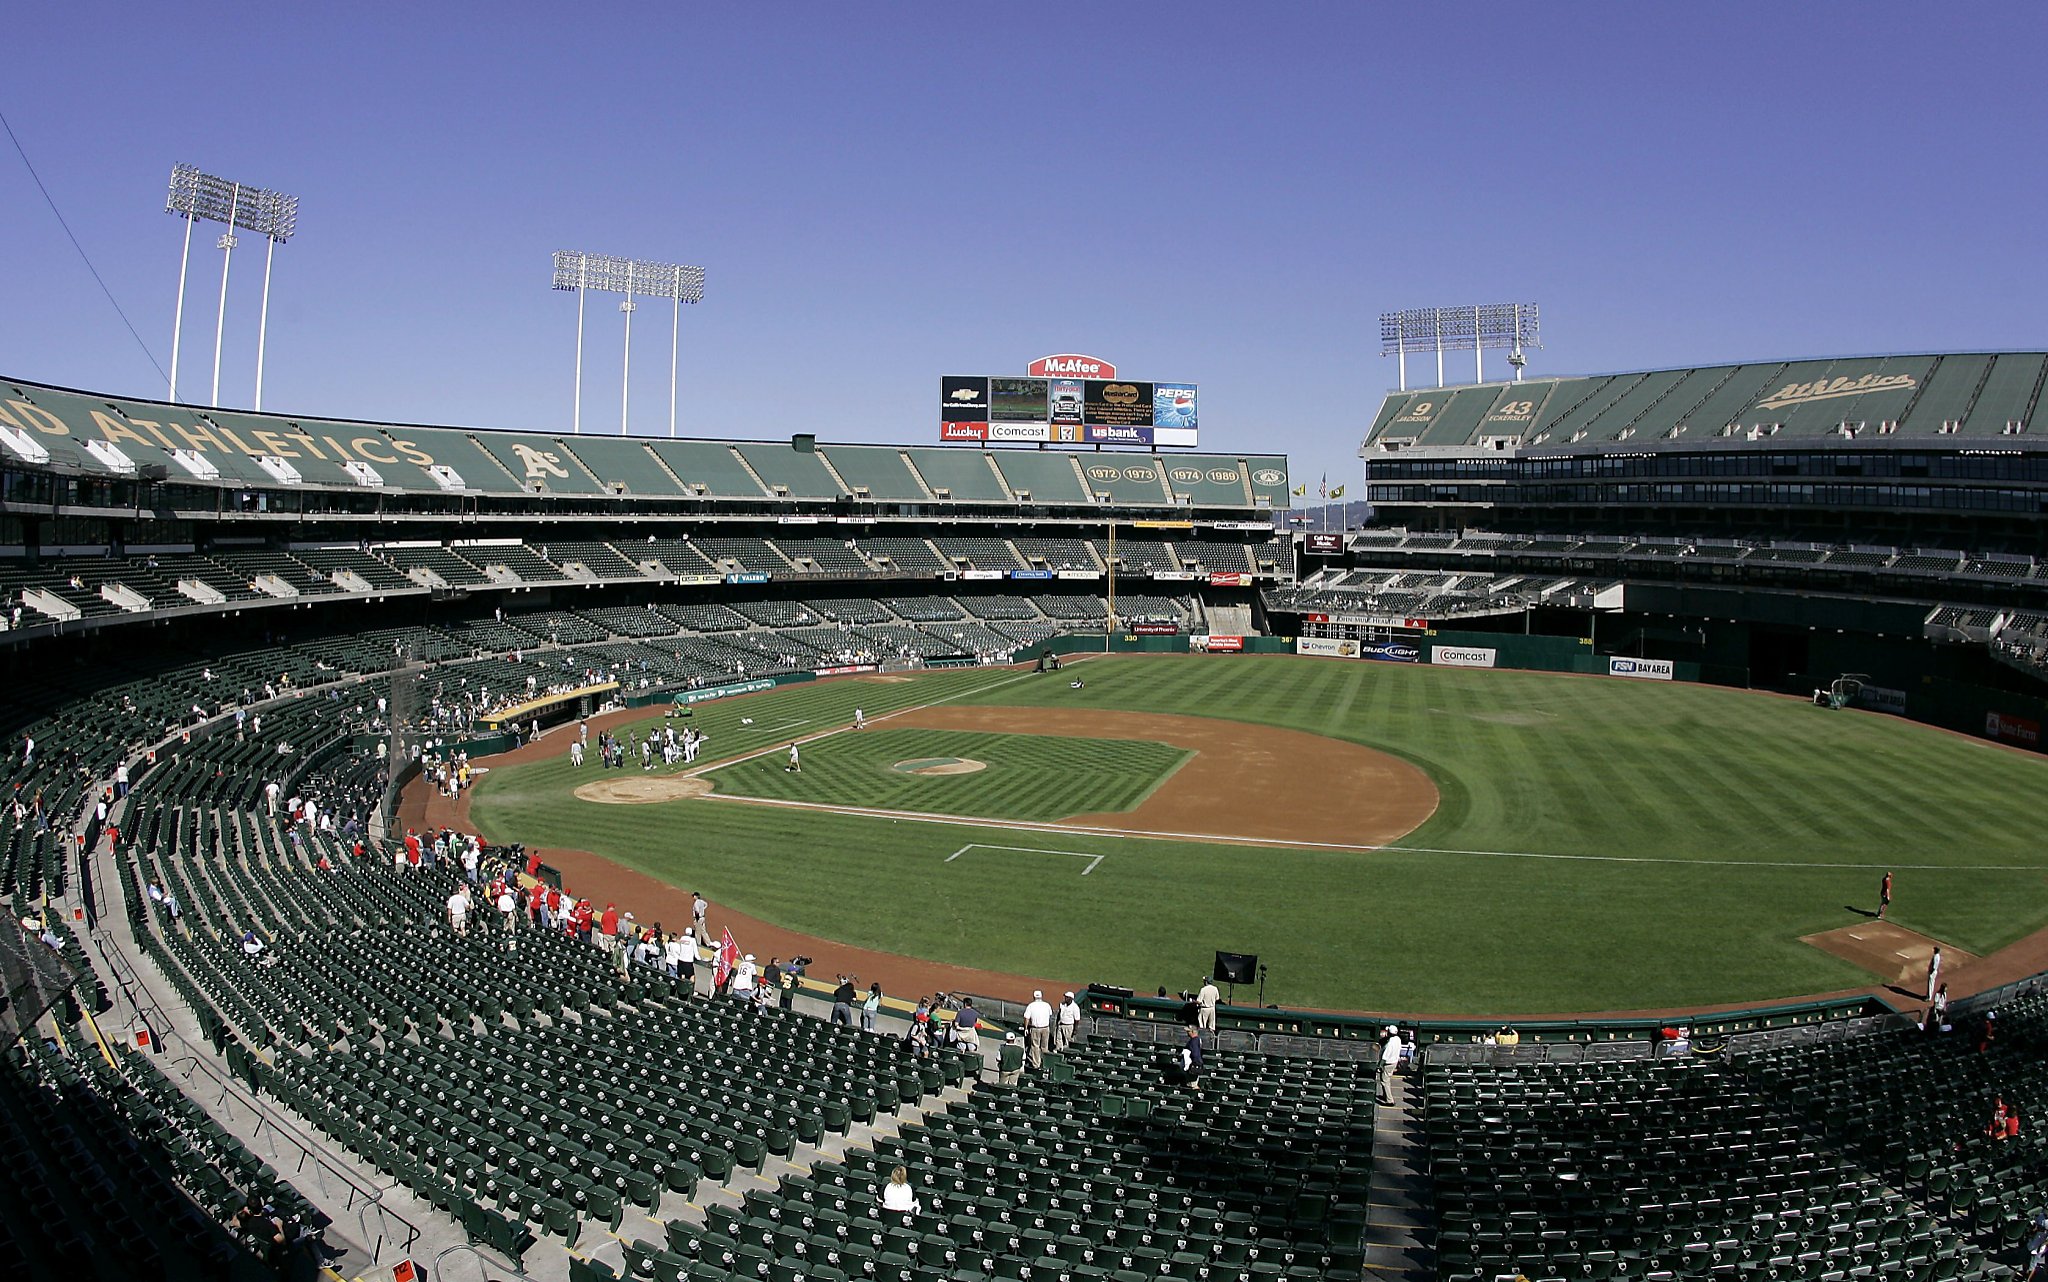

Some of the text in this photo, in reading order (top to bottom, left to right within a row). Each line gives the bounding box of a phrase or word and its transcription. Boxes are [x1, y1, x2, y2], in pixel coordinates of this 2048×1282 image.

[1044, 359, 1099, 373] McAfee
[1157, 388, 1195, 399] PEPSI
[1758, 374, 1915, 404] Athletics
[1412, 402, 1432, 416] 9
[1500, 401, 1533, 415] 43
[90, 410, 434, 466] ATHLETICS
[946, 423, 982, 440] Lucky
[512, 443, 569, 479] A's
[1090, 469, 1117, 479] 1972
[1129, 469, 1152, 480] 1973
[1173, 470, 1199, 480] 1974
[1210, 471, 1235, 481] 1989
[1389, 648, 1419, 656] LIGHT
[1615, 662, 1633, 671] FSN
[2017, 725, 2037, 742] Farm
